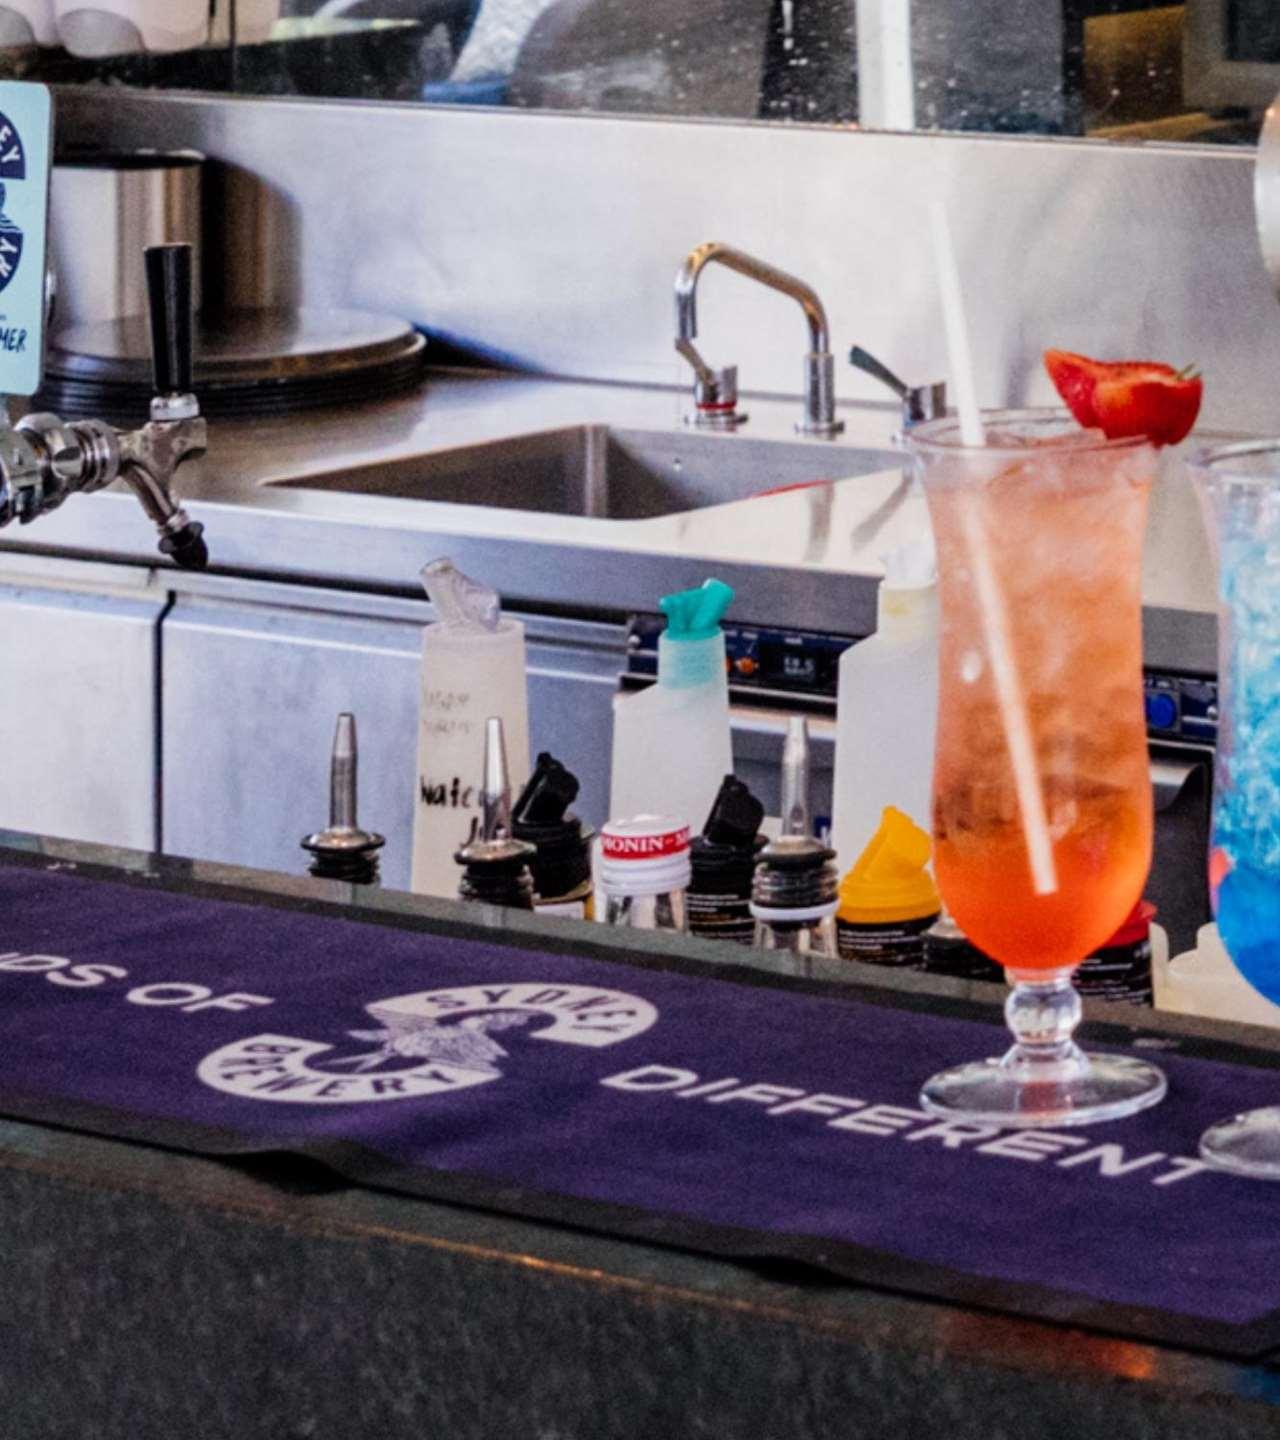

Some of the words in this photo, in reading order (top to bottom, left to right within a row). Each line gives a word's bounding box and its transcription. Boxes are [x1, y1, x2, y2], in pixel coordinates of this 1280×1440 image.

[125, 982, 275, 1013] OF
[425, 988, 625, 1035] SYDNEY
[216, 1041, 458, 1098] BREWERY
[600, 1064, 1213, 1186] DIFFERENT
